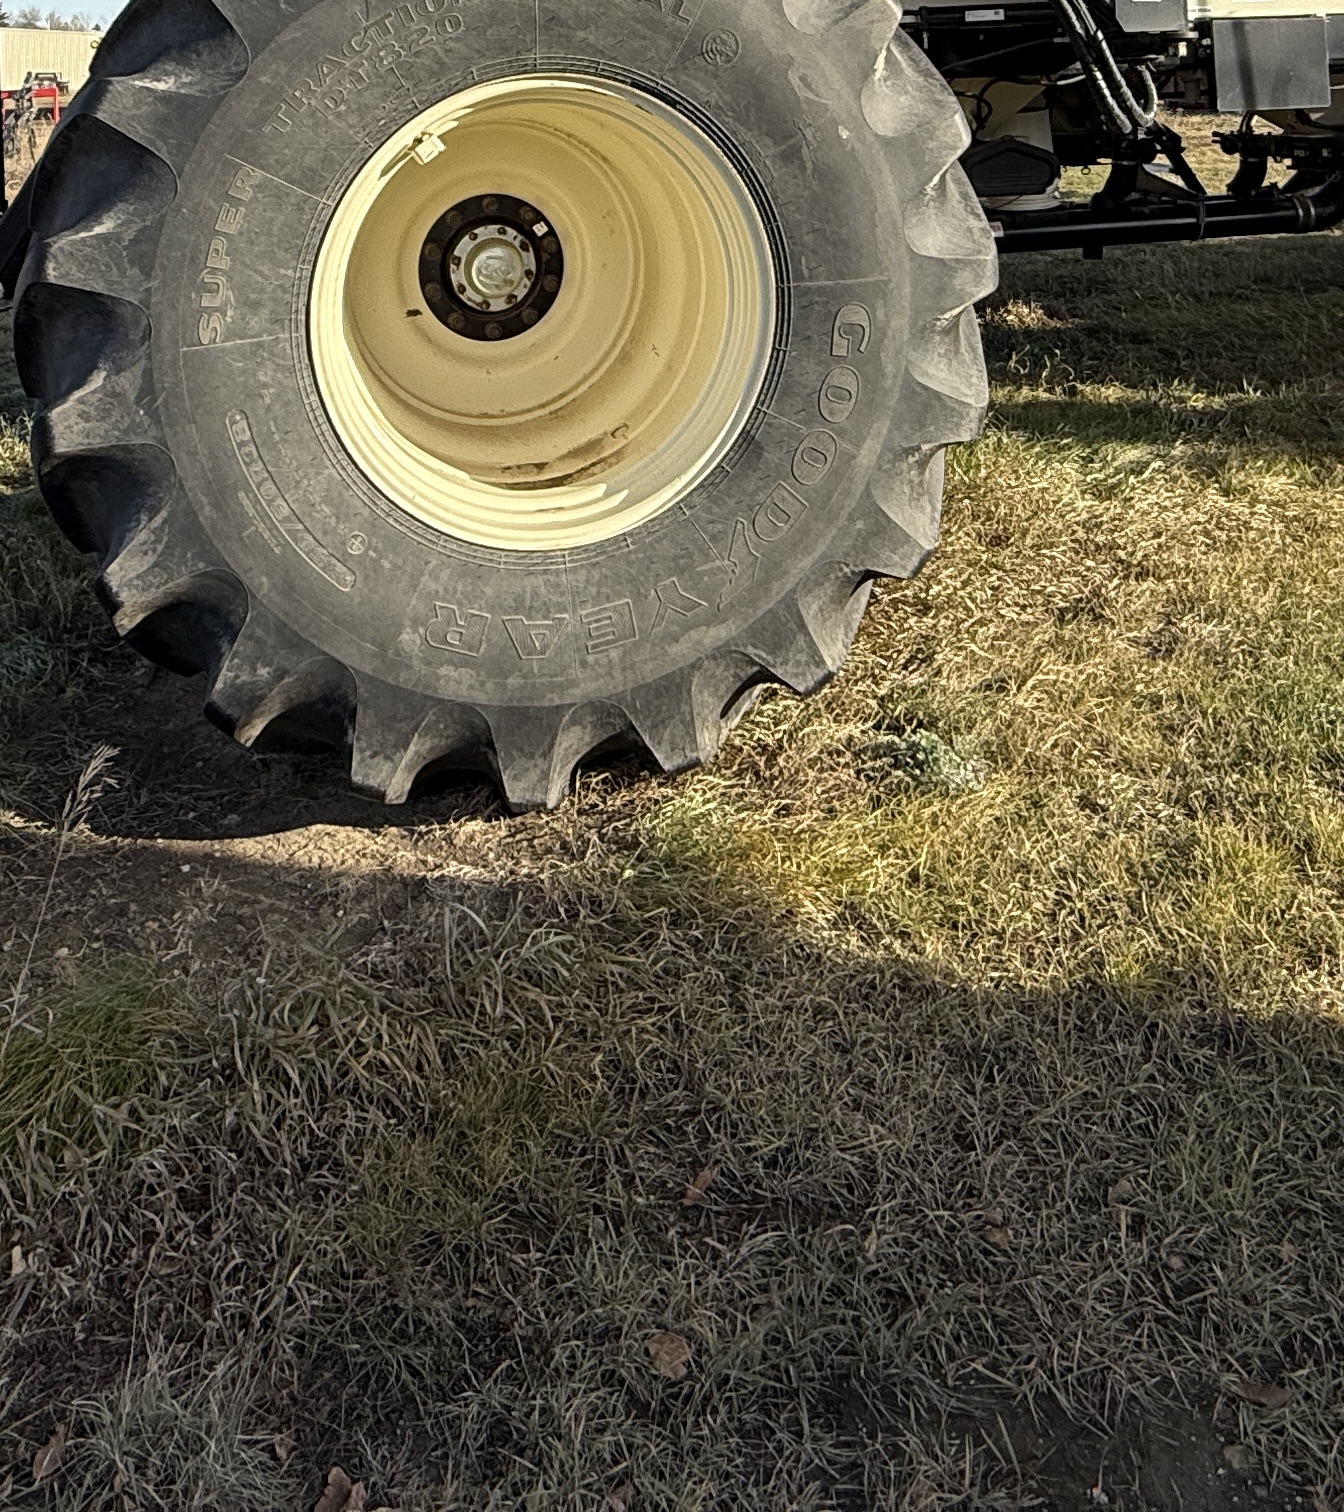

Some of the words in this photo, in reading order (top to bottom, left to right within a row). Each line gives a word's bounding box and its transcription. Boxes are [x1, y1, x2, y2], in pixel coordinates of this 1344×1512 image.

[314, 13, 465, 120] DT820
[198, 166, 260, 345] SUPER
[425, 302, 872, 659] GOODYEAR
